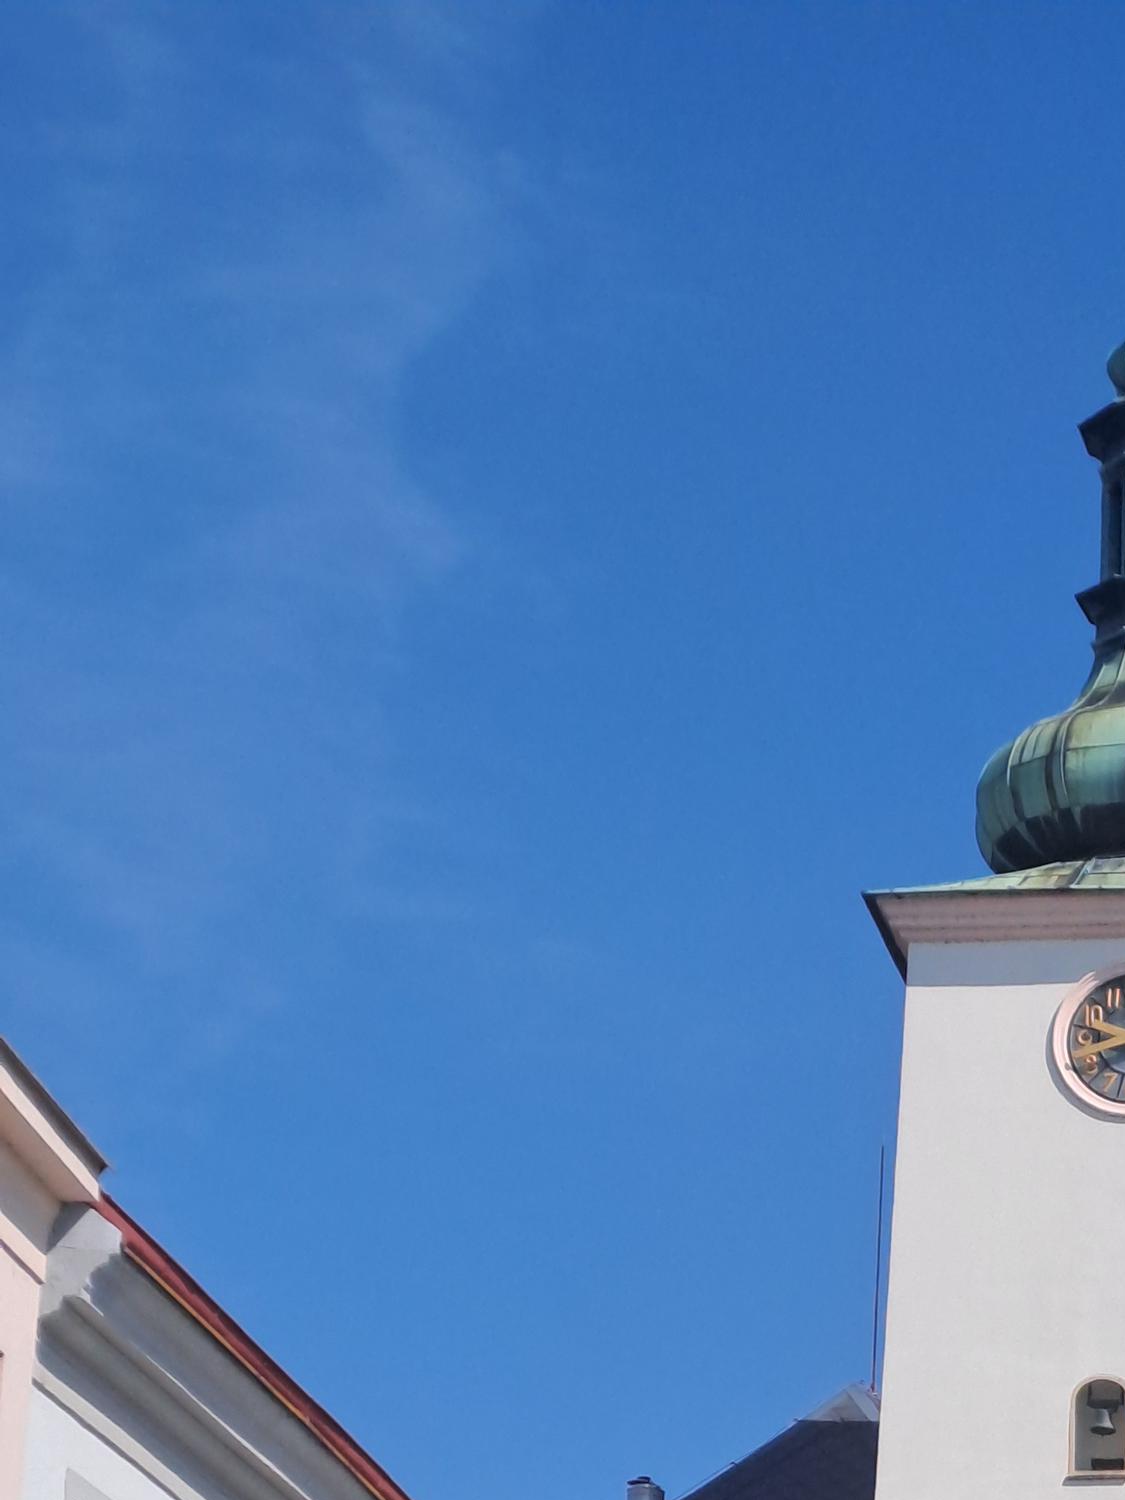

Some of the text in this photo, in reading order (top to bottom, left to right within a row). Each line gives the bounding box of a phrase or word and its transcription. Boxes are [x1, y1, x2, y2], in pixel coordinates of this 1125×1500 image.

[1106, 987, 1121, 1008] 11
[1084, 1004, 1103, 1026] 10
[1103, 1072, 1118, 1092] 7
